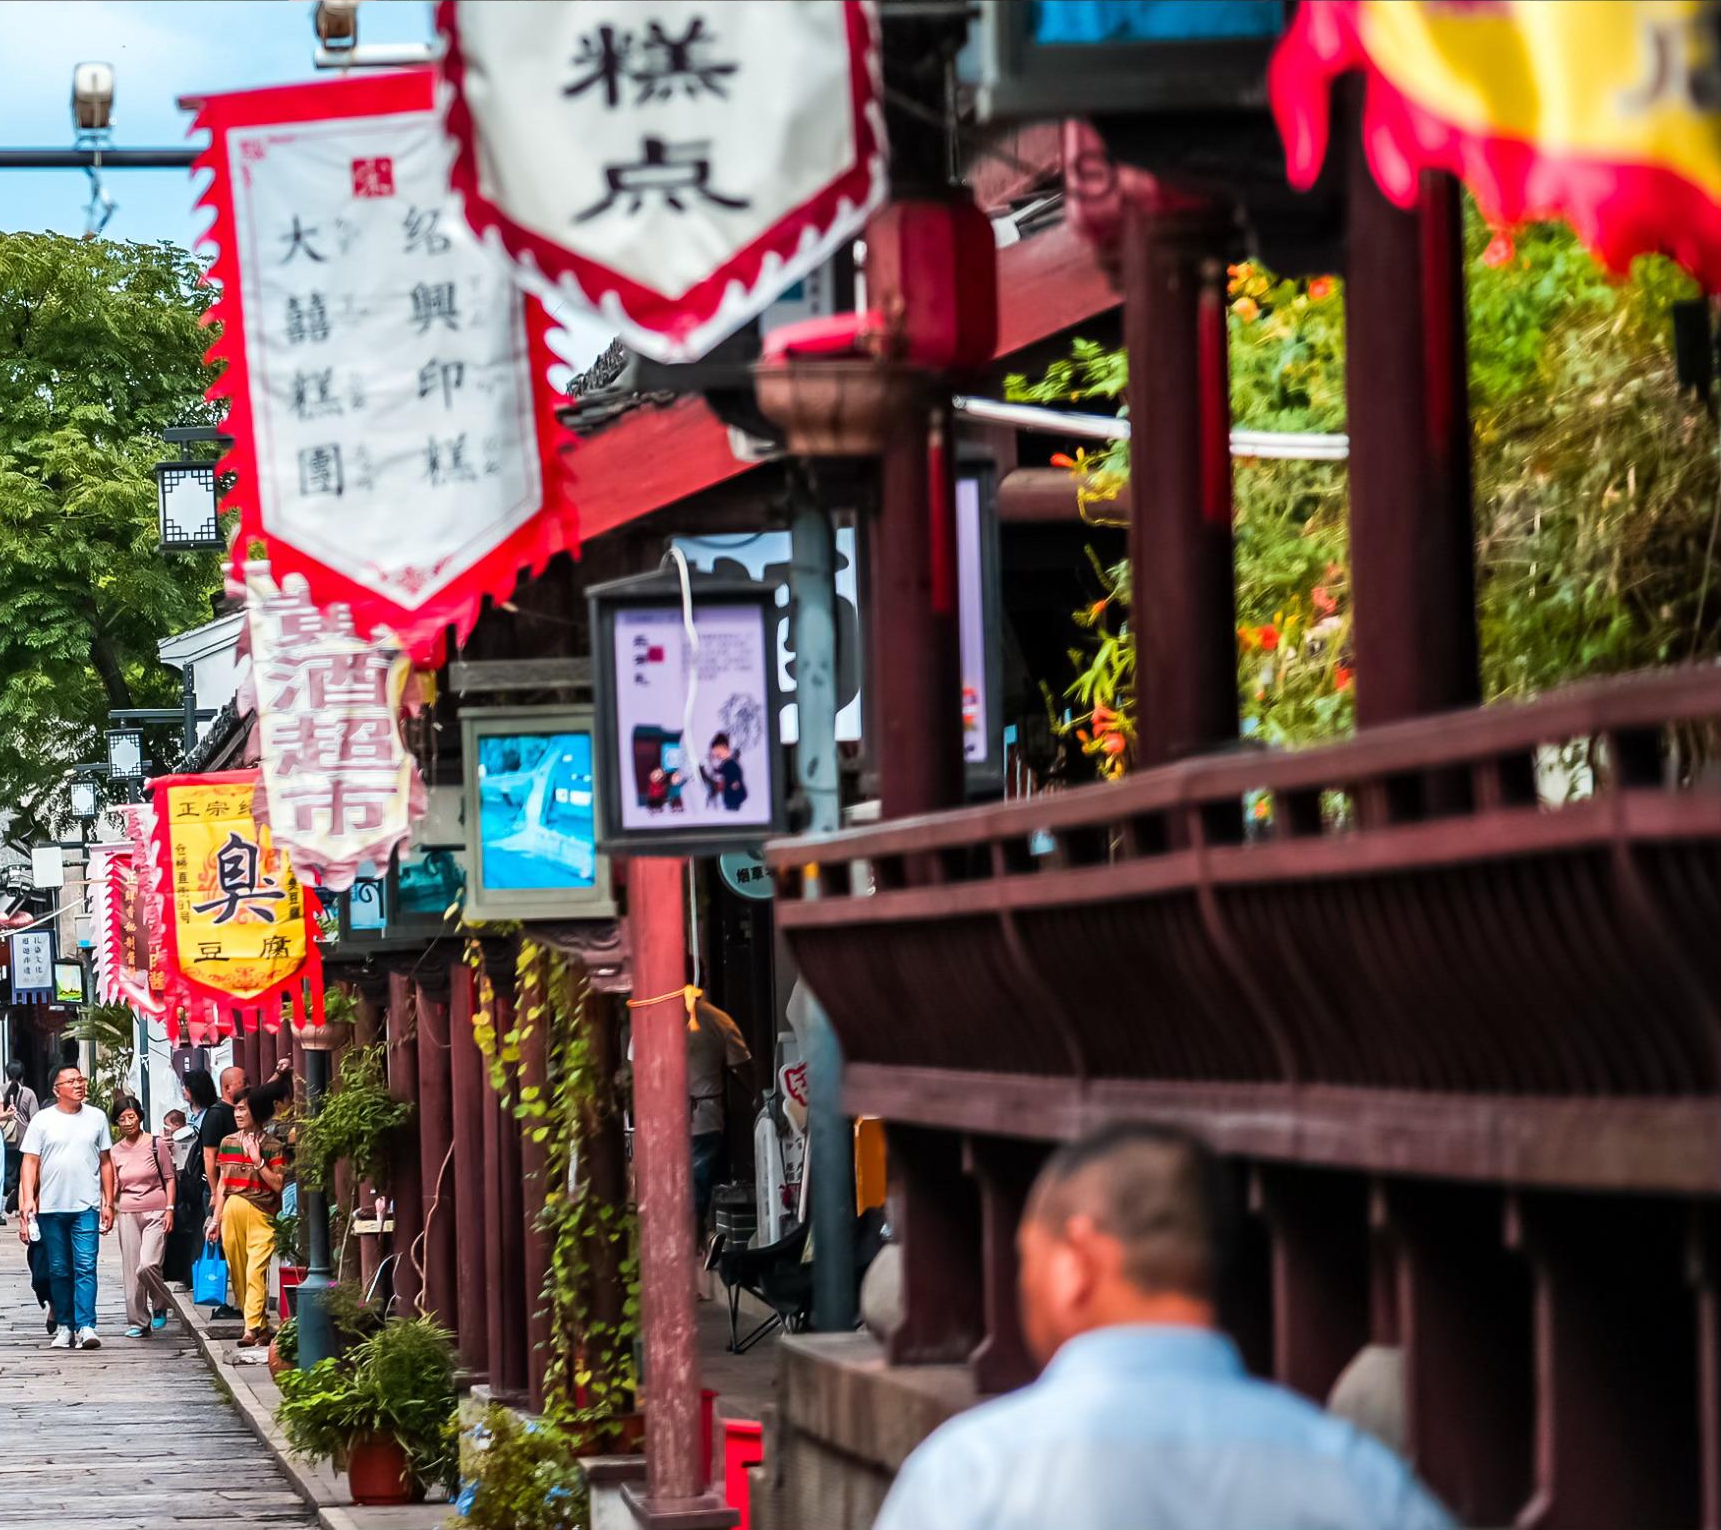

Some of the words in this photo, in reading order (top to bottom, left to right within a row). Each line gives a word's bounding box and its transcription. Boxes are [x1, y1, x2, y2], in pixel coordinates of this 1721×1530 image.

[564, 15, 750, 224] 糕点
[192, 831, 286, 924] 臭
[736, 865, 770, 884] 烟草
[193, 935, 293, 964] 豆腐
